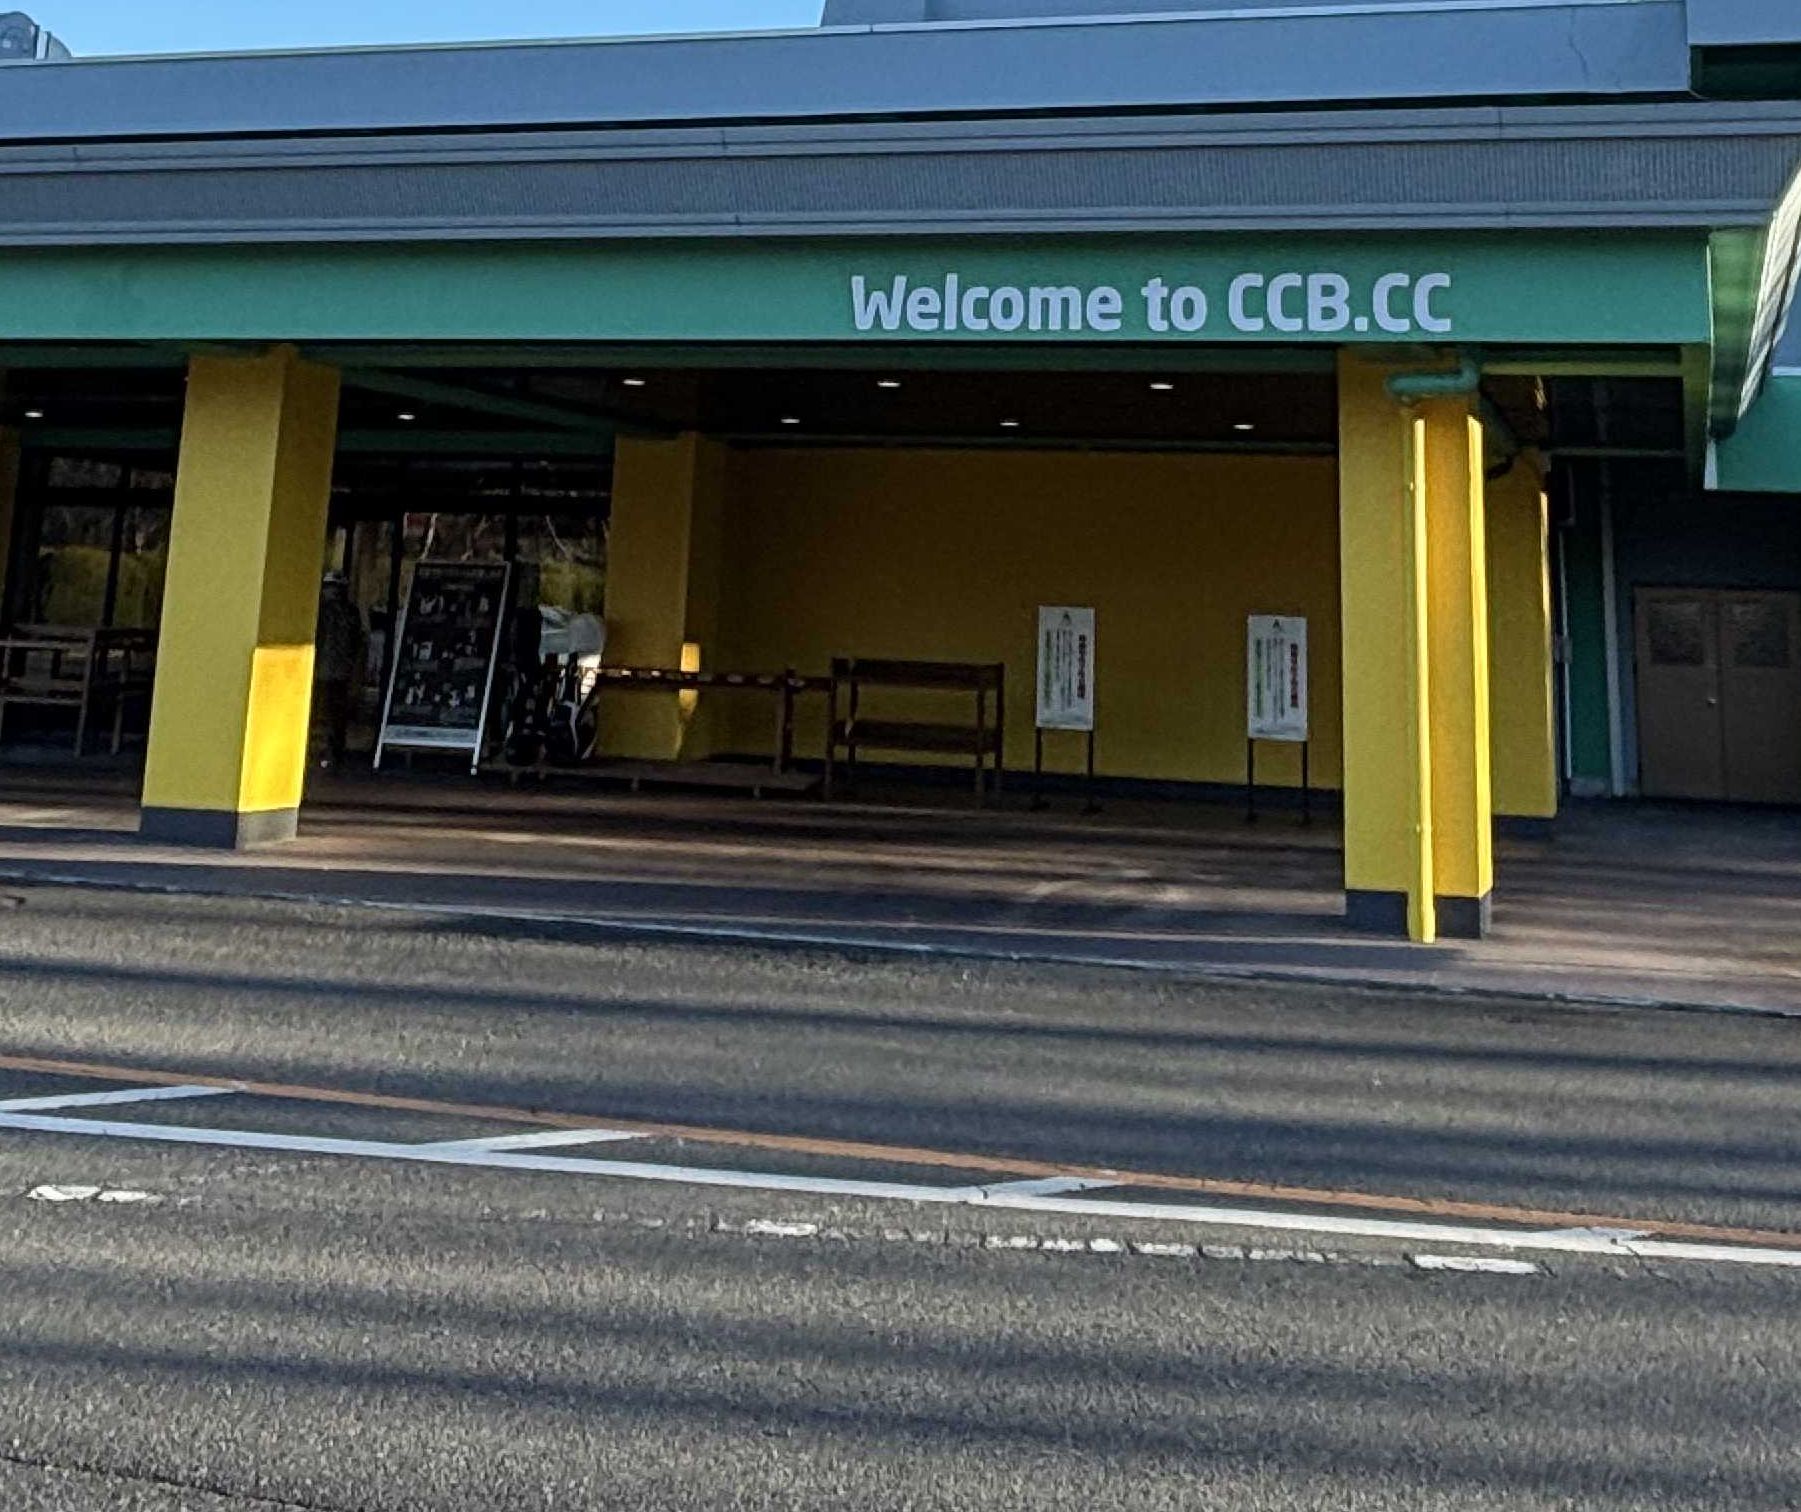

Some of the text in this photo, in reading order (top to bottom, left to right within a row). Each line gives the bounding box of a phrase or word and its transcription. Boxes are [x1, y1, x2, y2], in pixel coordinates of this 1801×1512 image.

[851, 272, 1452, 332] Welcome to CCB.CC
